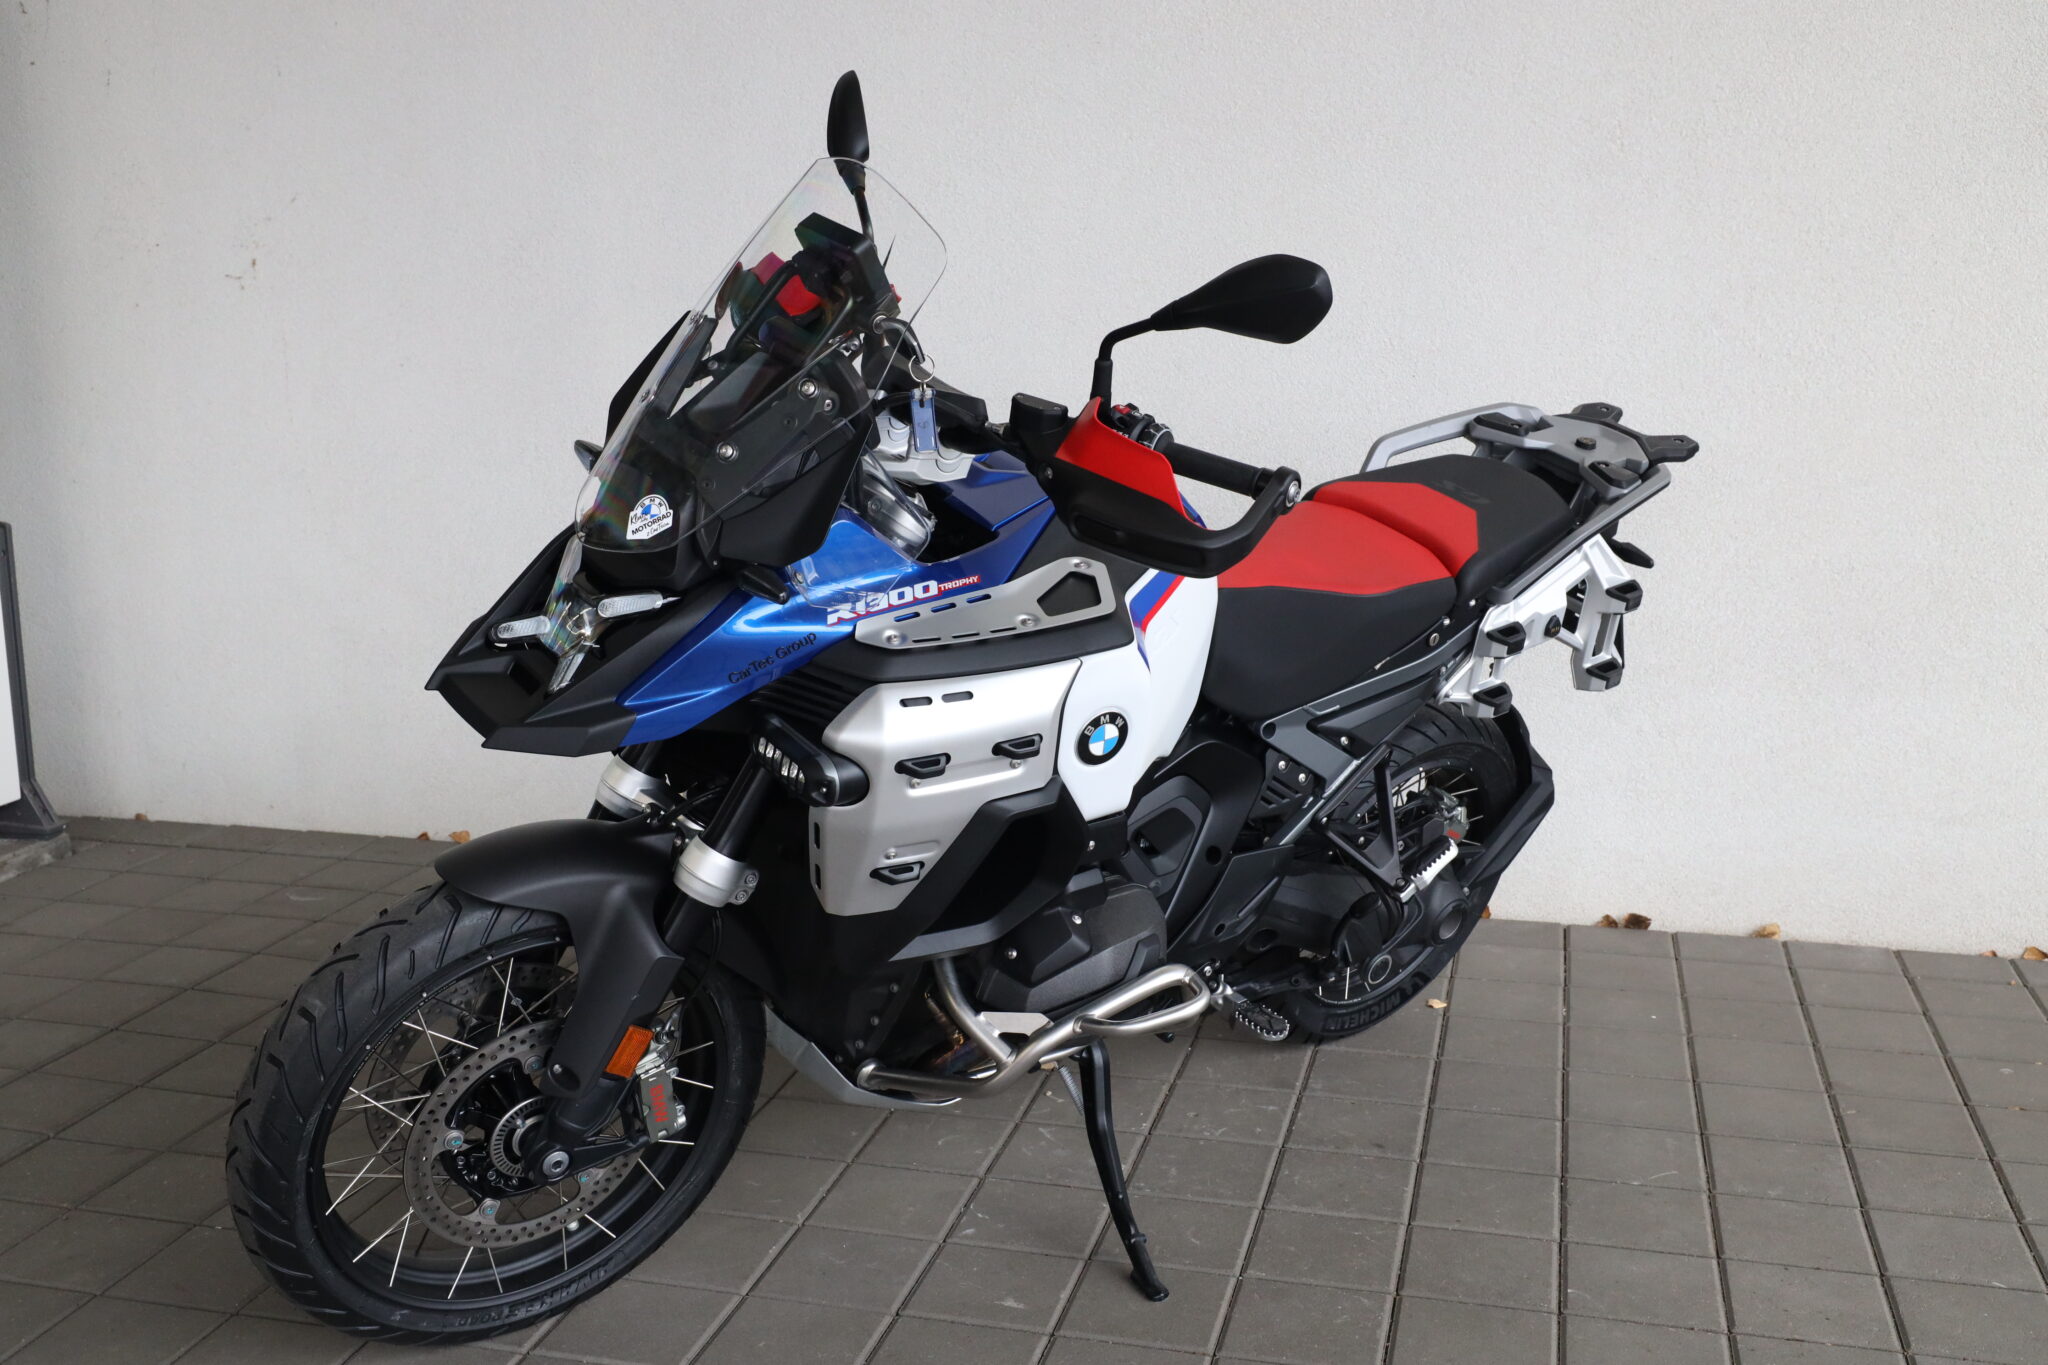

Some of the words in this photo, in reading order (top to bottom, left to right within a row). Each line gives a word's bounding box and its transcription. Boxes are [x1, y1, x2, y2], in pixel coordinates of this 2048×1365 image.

[631, 511, 672, 536] MOTORRAD
[938, 575, 979, 591] TROPHY
[727, 656, 776, 684] CarTec
[775, 631, 818, 660] Group
[1084, 714, 1125, 736] BMW
[1325, 991, 1402, 1030] MICHELIN
[649, 1084, 669, 1123] BMW
